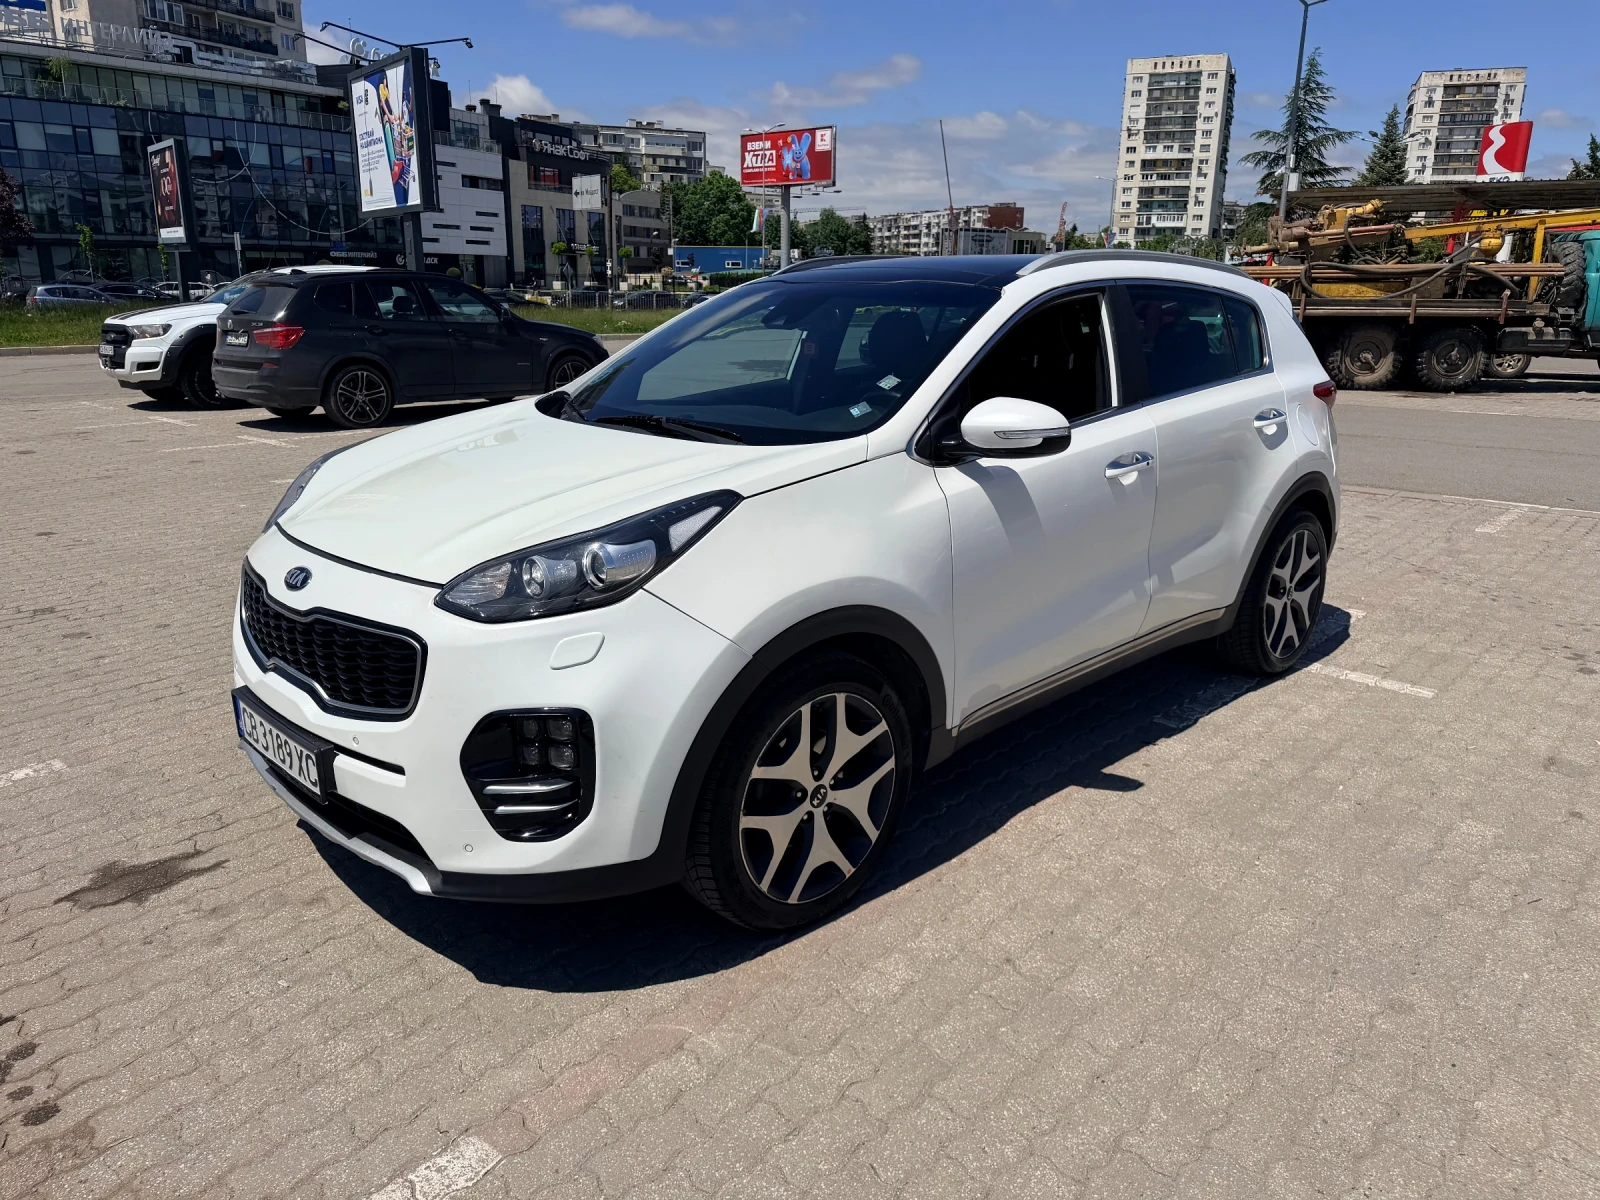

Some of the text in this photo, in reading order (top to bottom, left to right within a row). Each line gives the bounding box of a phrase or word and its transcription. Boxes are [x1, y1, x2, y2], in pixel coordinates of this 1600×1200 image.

[747, 141, 771, 150] ВЗЕМИ
[259, 720, 293, 771] 3189
[812, 788, 826, 806] KIA
